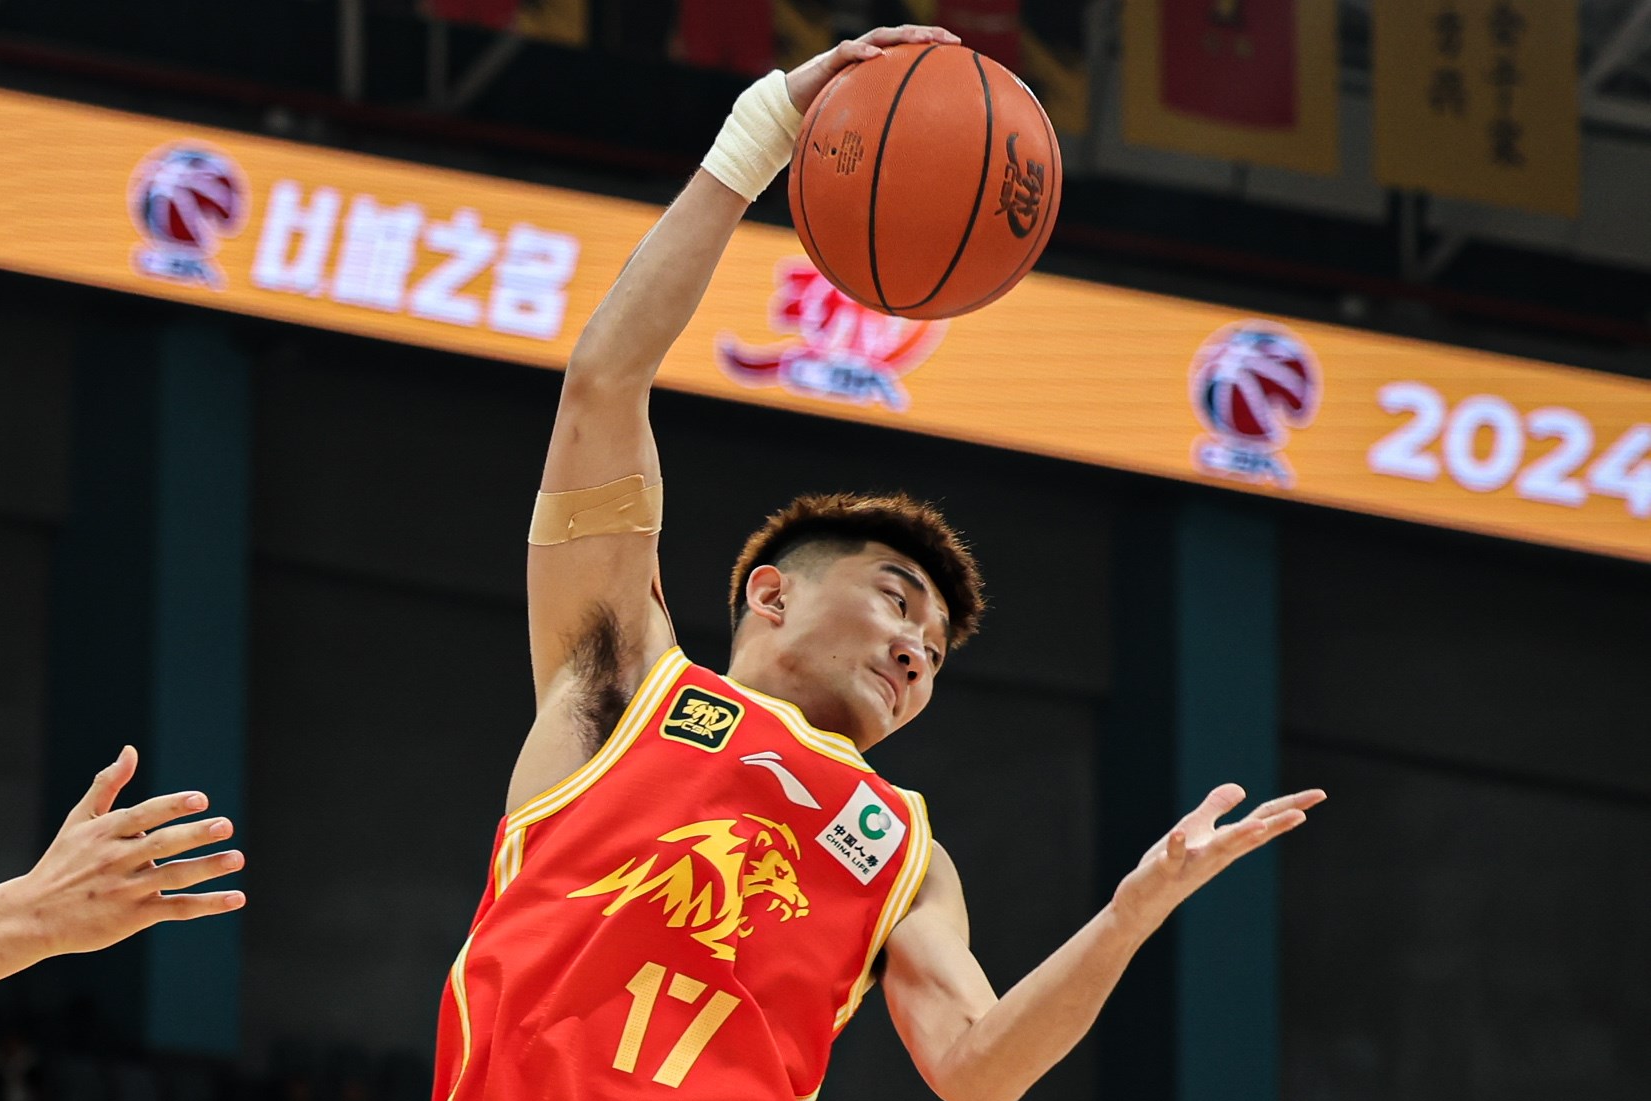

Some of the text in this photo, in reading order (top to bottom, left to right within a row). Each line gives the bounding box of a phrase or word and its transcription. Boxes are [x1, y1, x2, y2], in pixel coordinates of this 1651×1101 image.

[1368, 382, 1651, 517] 2024
[826, 834, 870, 875] CHINA LIFE
[612, 961, 742, 1089] 17
